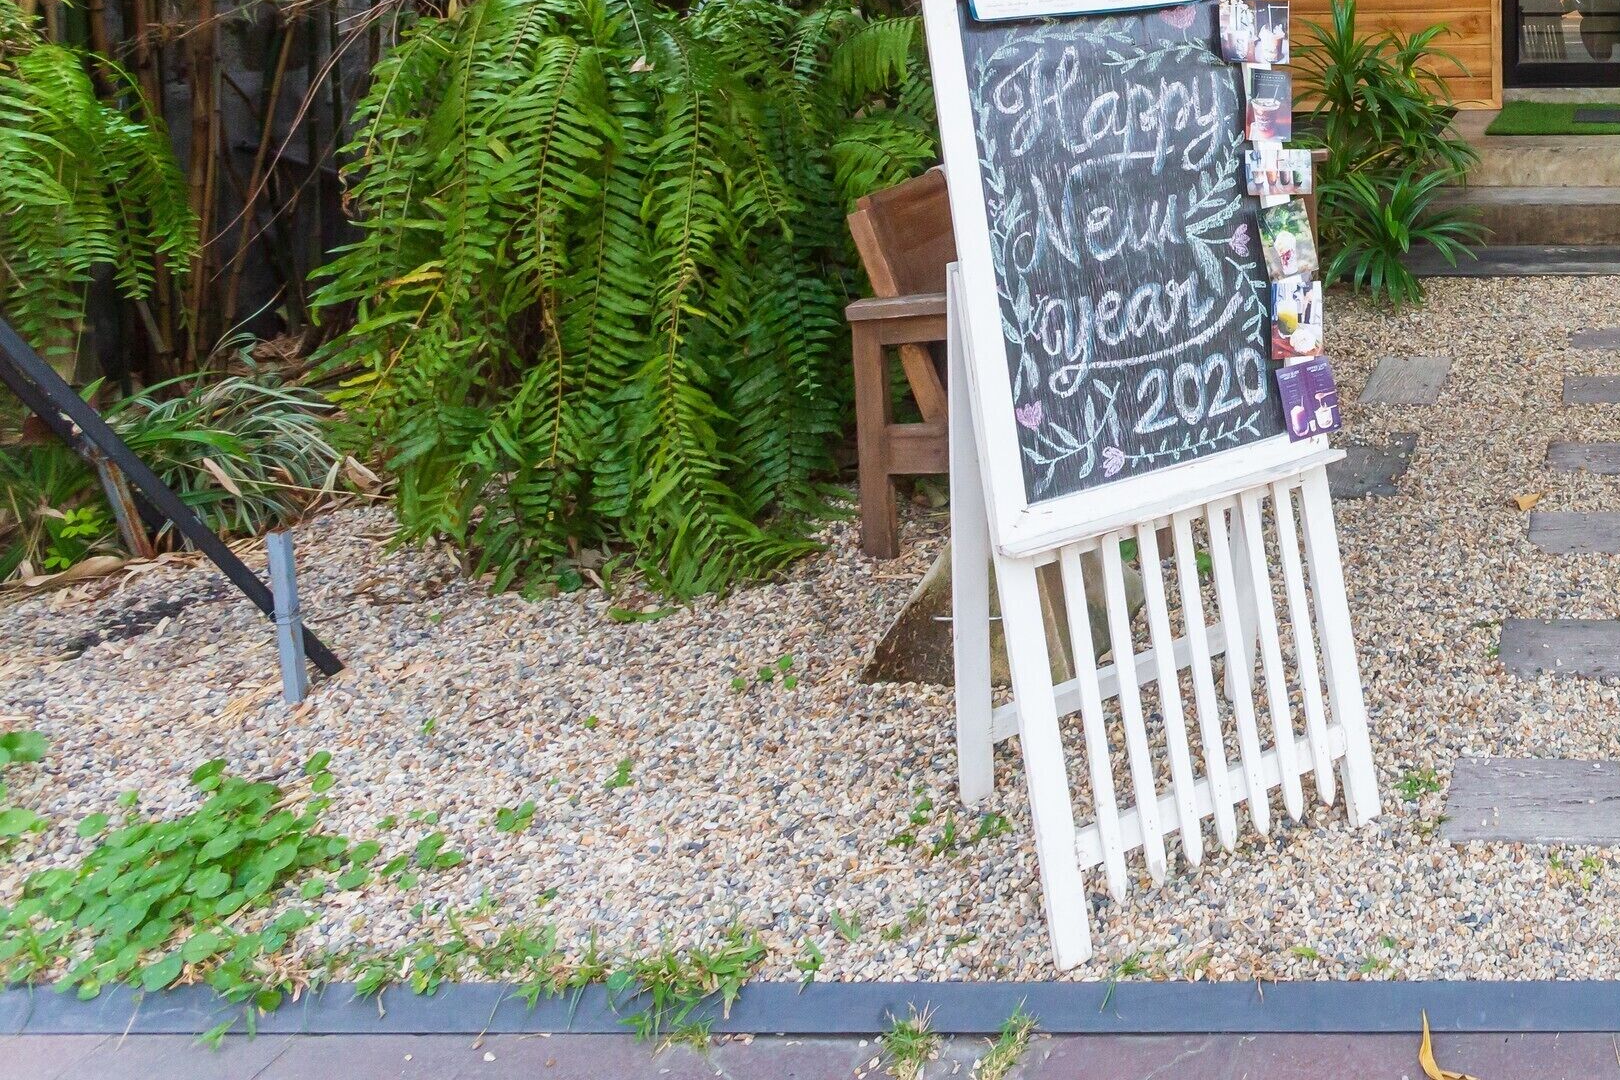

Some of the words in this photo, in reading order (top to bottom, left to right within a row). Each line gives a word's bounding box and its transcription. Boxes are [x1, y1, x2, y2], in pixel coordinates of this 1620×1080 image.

[993, 46, 1224, 176] Happy
[1013, 173, 1187, 273] New
[1134, 348, 1267, 434] 2020
